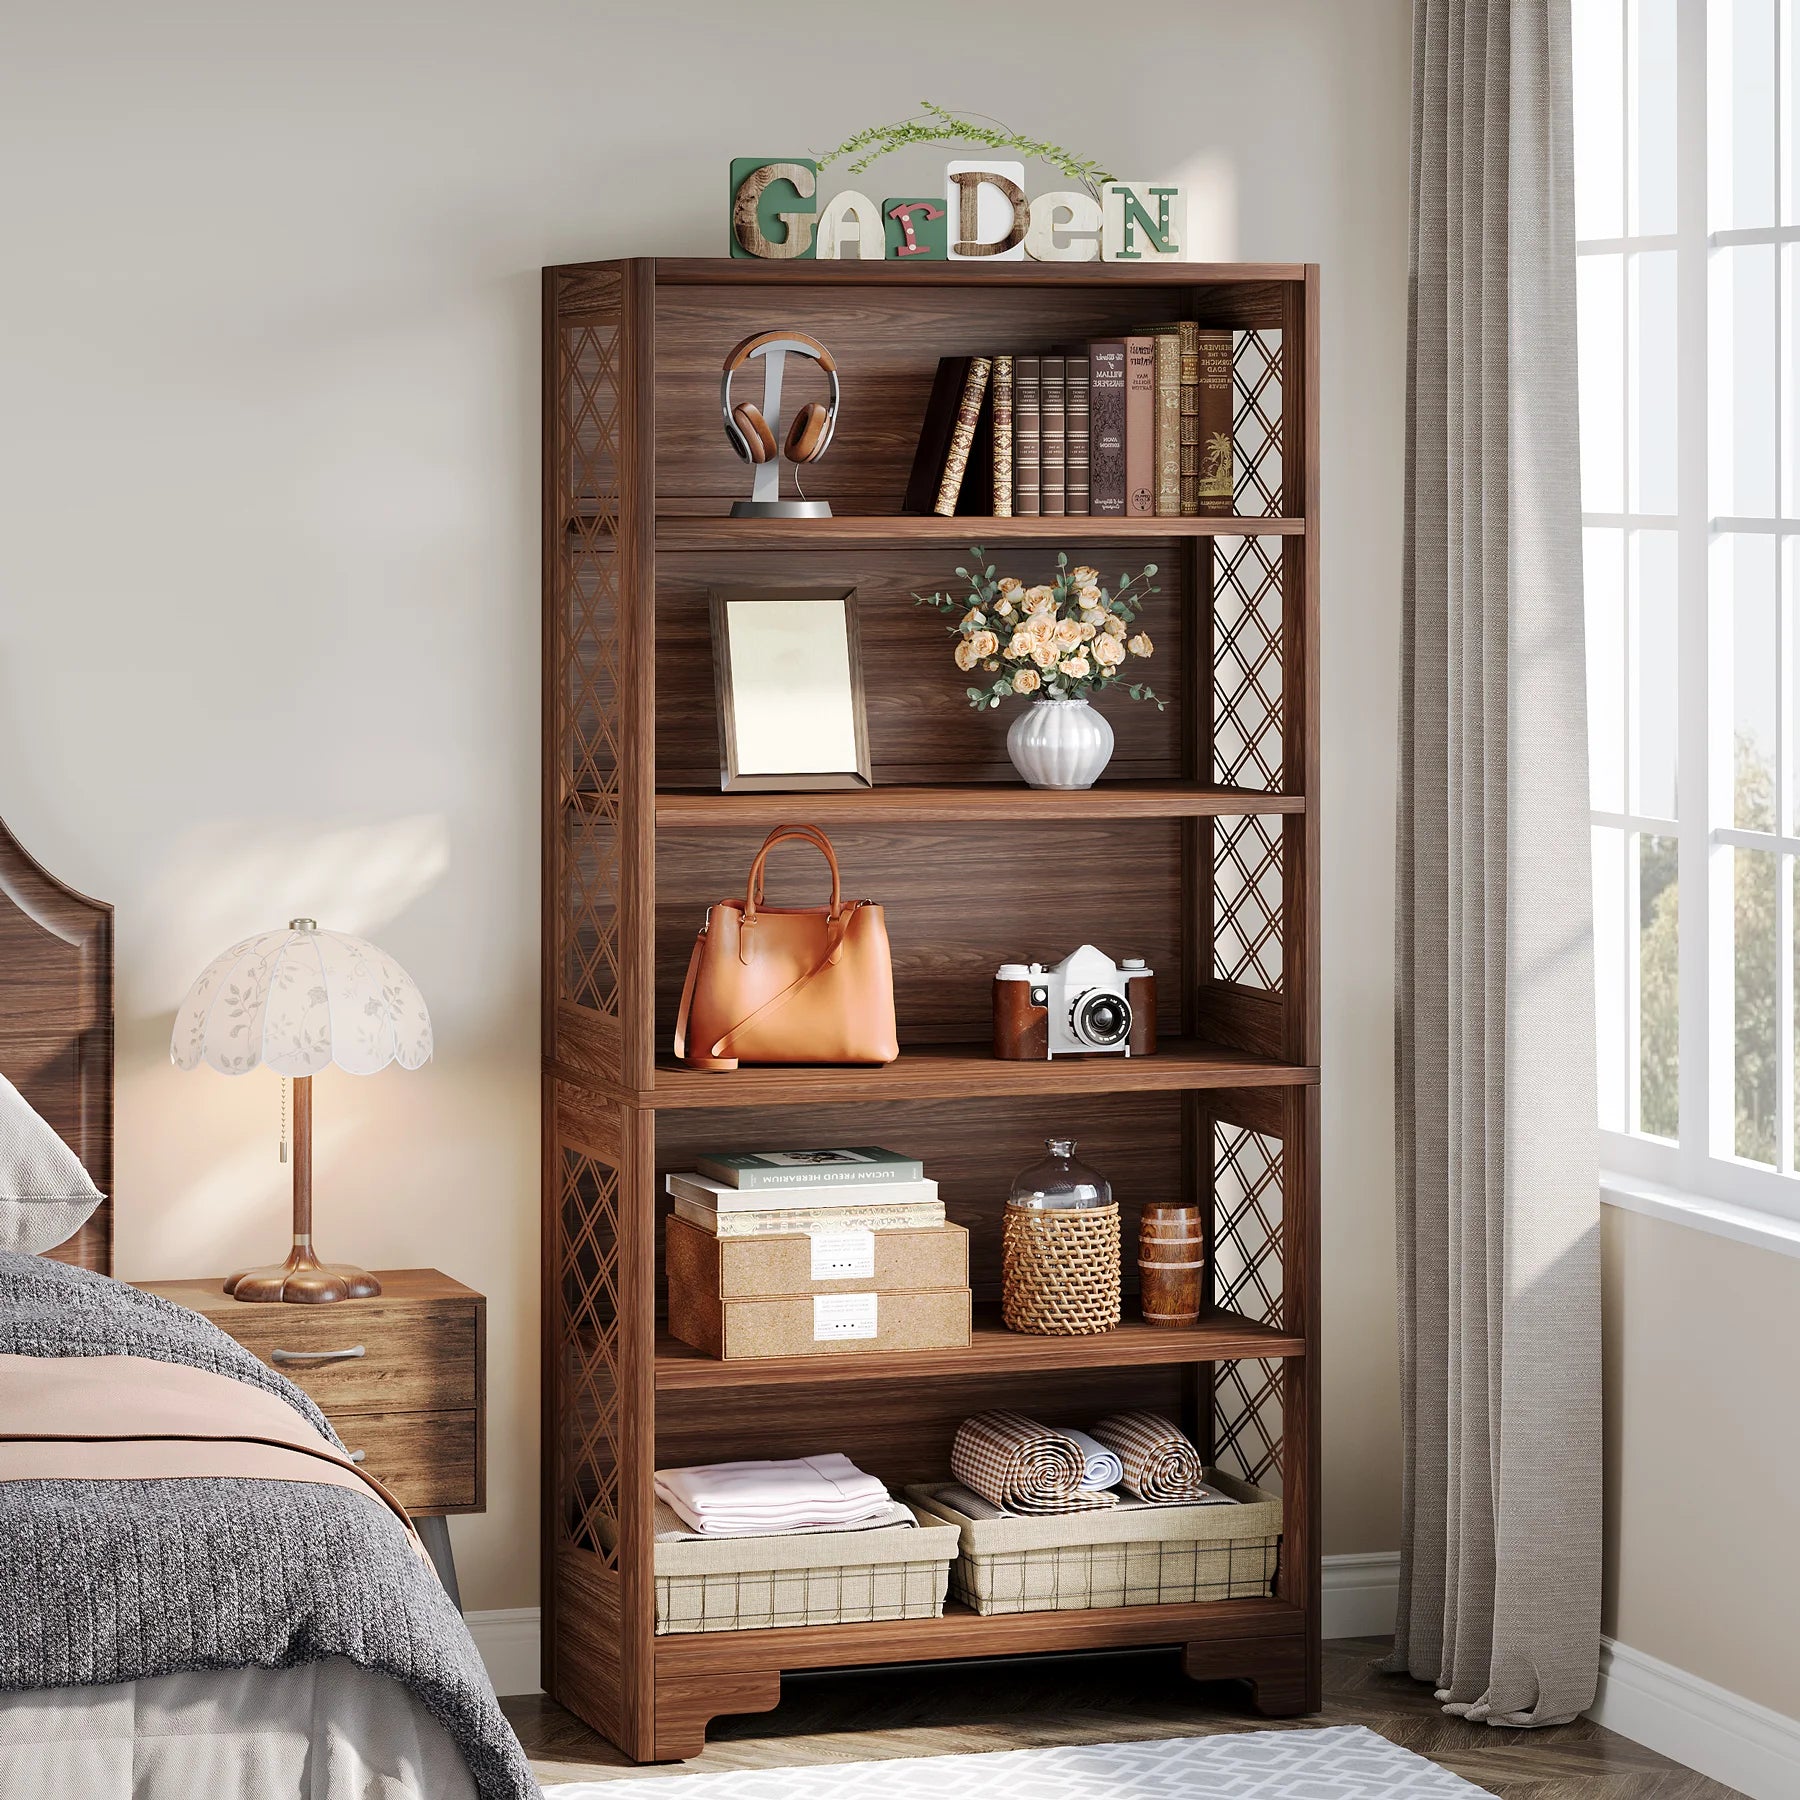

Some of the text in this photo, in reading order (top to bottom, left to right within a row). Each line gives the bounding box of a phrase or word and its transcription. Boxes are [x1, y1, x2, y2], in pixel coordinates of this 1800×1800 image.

[762, 1173, 822, 1183] HERBARIUM
[823, 1172, 856, 1181] FREUD
[857, 1171, 895, 1179] LUCIAN
